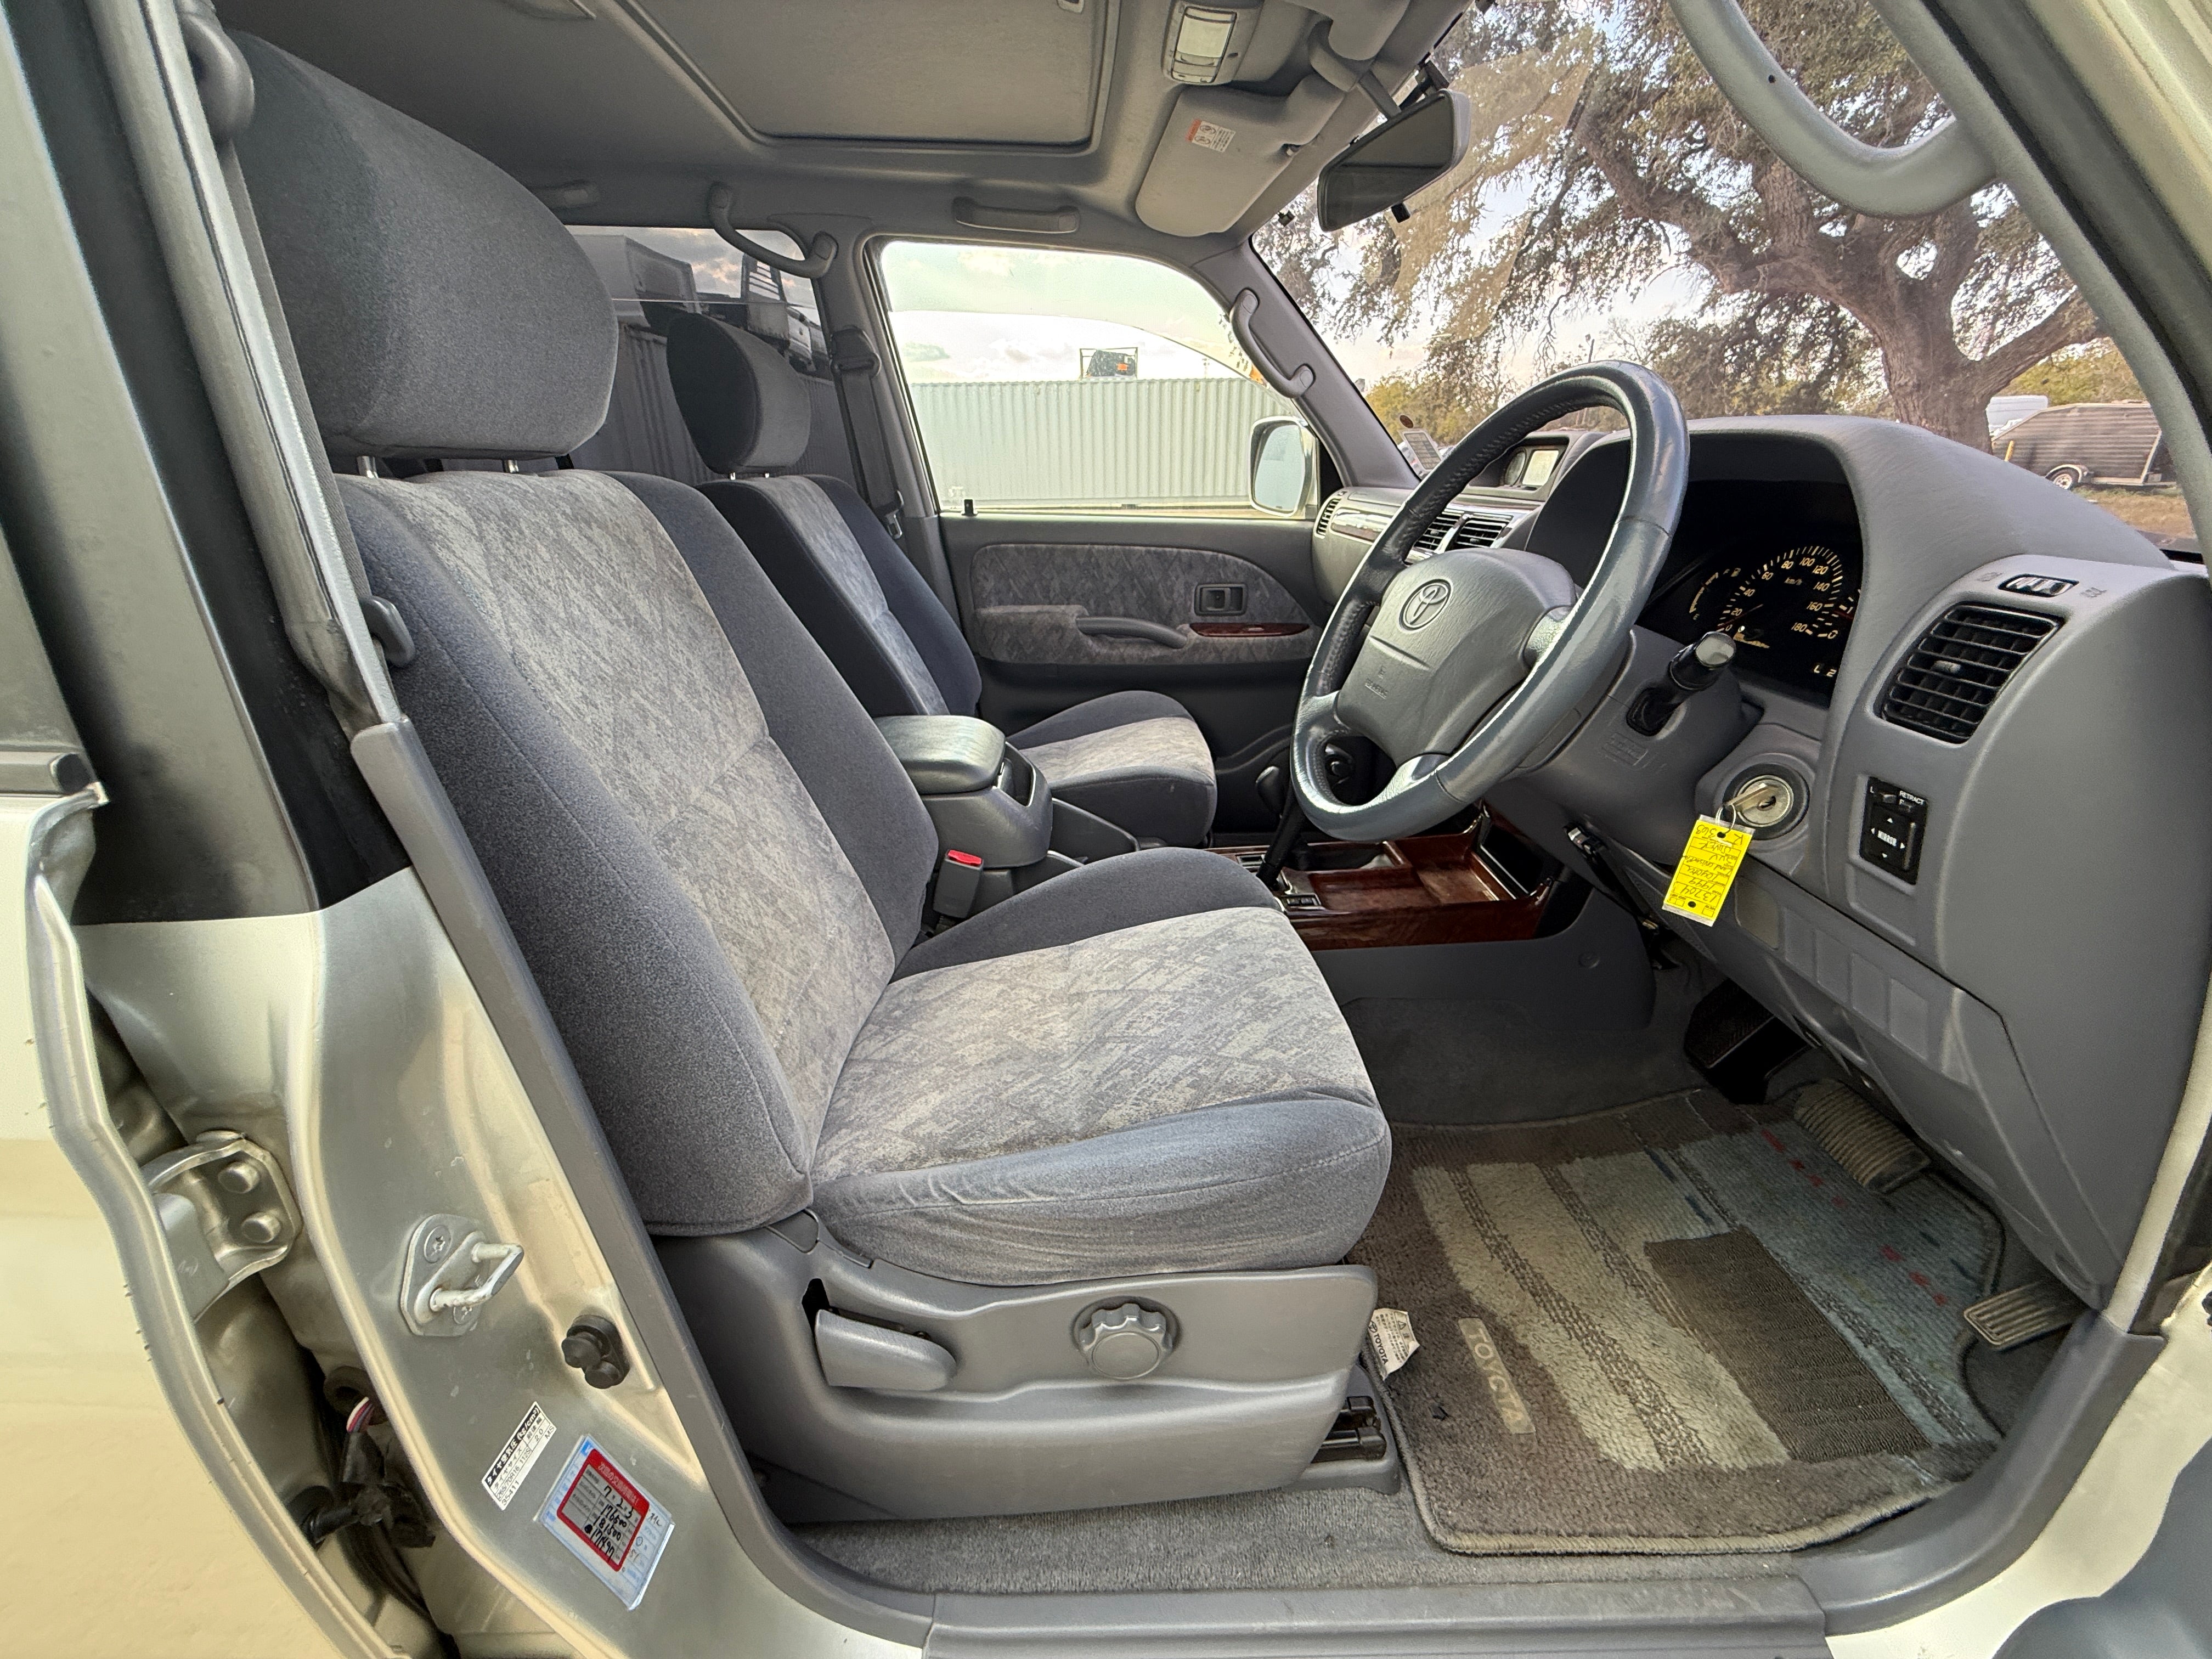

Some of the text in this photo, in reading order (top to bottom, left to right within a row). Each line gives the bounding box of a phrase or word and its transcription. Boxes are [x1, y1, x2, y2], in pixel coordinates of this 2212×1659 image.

[1781, 560, 1794, 569] 80
[1799, 557, 1815, 567] 100
[1812, 565, 1829, 575] 120
[1762, 571, 1774, 580] 60
[1813, 582, 1830, 591] 140
[1743, 589, 1756, 597] 40
[1806, 601, 1822, 612] 160
[1731, 608, 1742, 616] 20
[1791, 622, 1808, 632] 180
[1899, 791, 1925, 805] RETRACT
[1685, 865, 1718, 882] Toyota
[1689, 877, 1715, 891] 1999
[1680, 885, 1717, 902] 13704
[1374, 1333, 1388, 1364] TOYOTA
